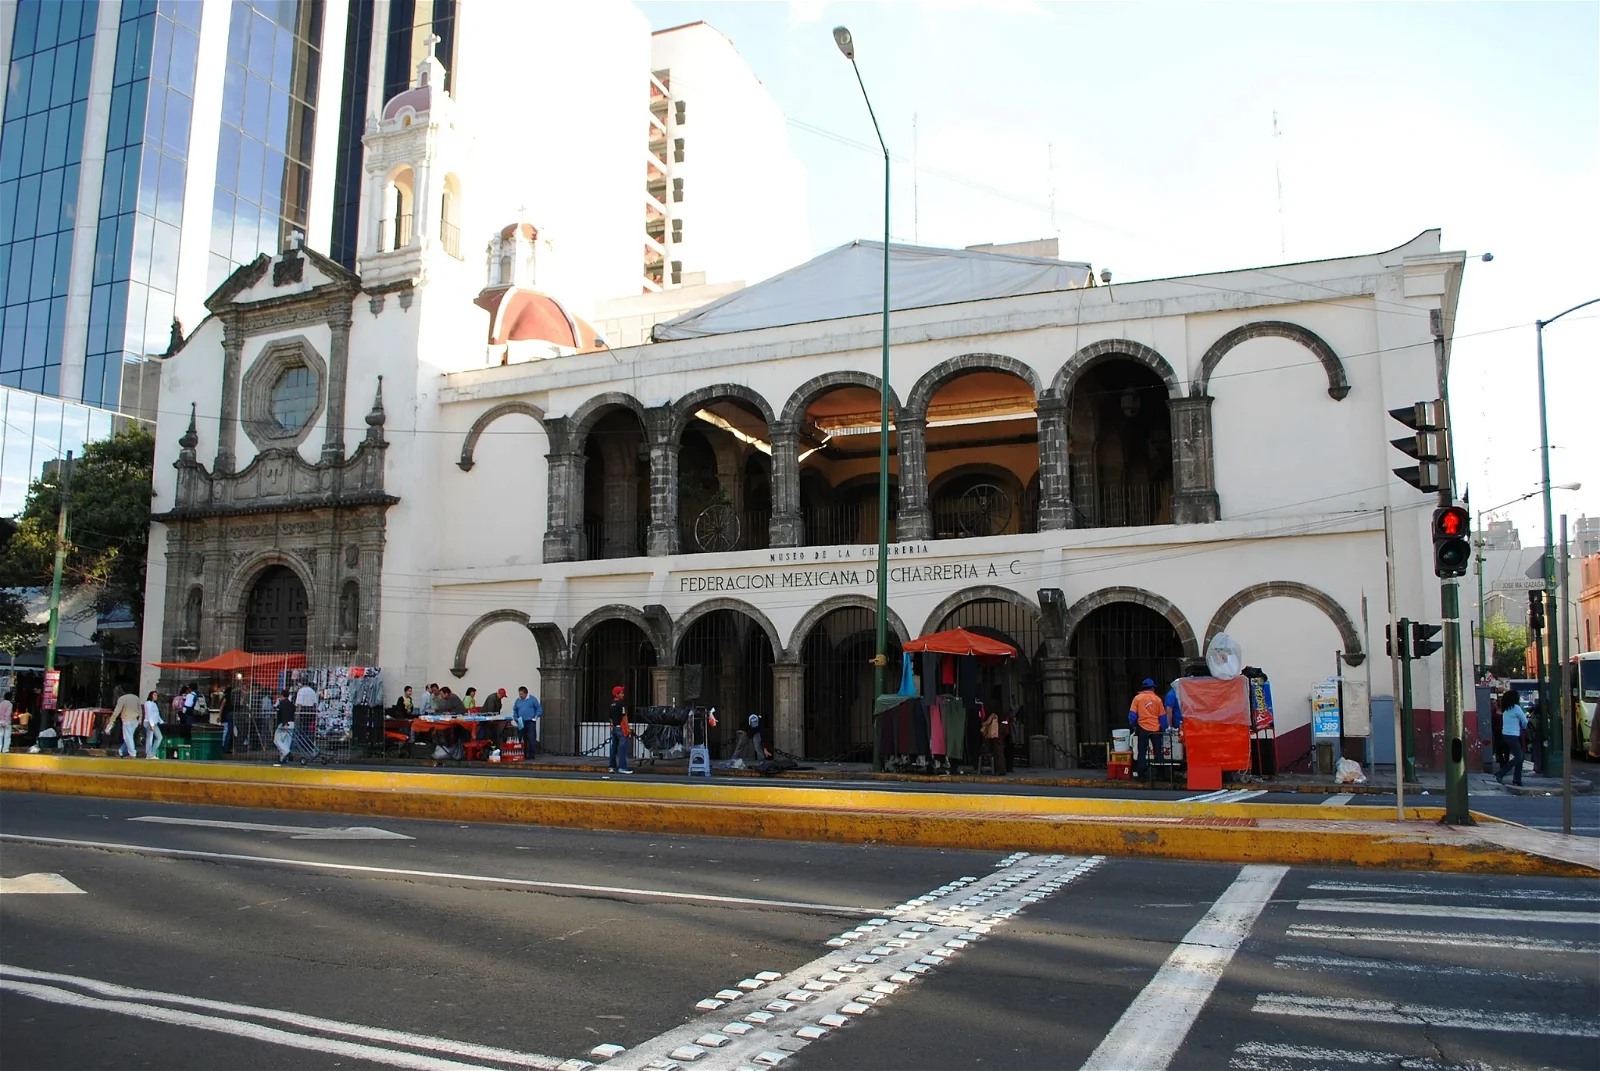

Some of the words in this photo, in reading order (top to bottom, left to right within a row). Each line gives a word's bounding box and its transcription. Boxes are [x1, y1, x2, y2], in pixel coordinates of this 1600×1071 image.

[770, 552, 805, 562] MUSEO
[815, 550, 827, 560] DE
[838, 549, 851, 558] LA
[862, 545, 928, 556] CHRRERIA
[680, 573, 775, 592] FEDERACION
[782, 570, 860, 588] MEXICANA
[890, 563, 979, 582] CHARRERIA
